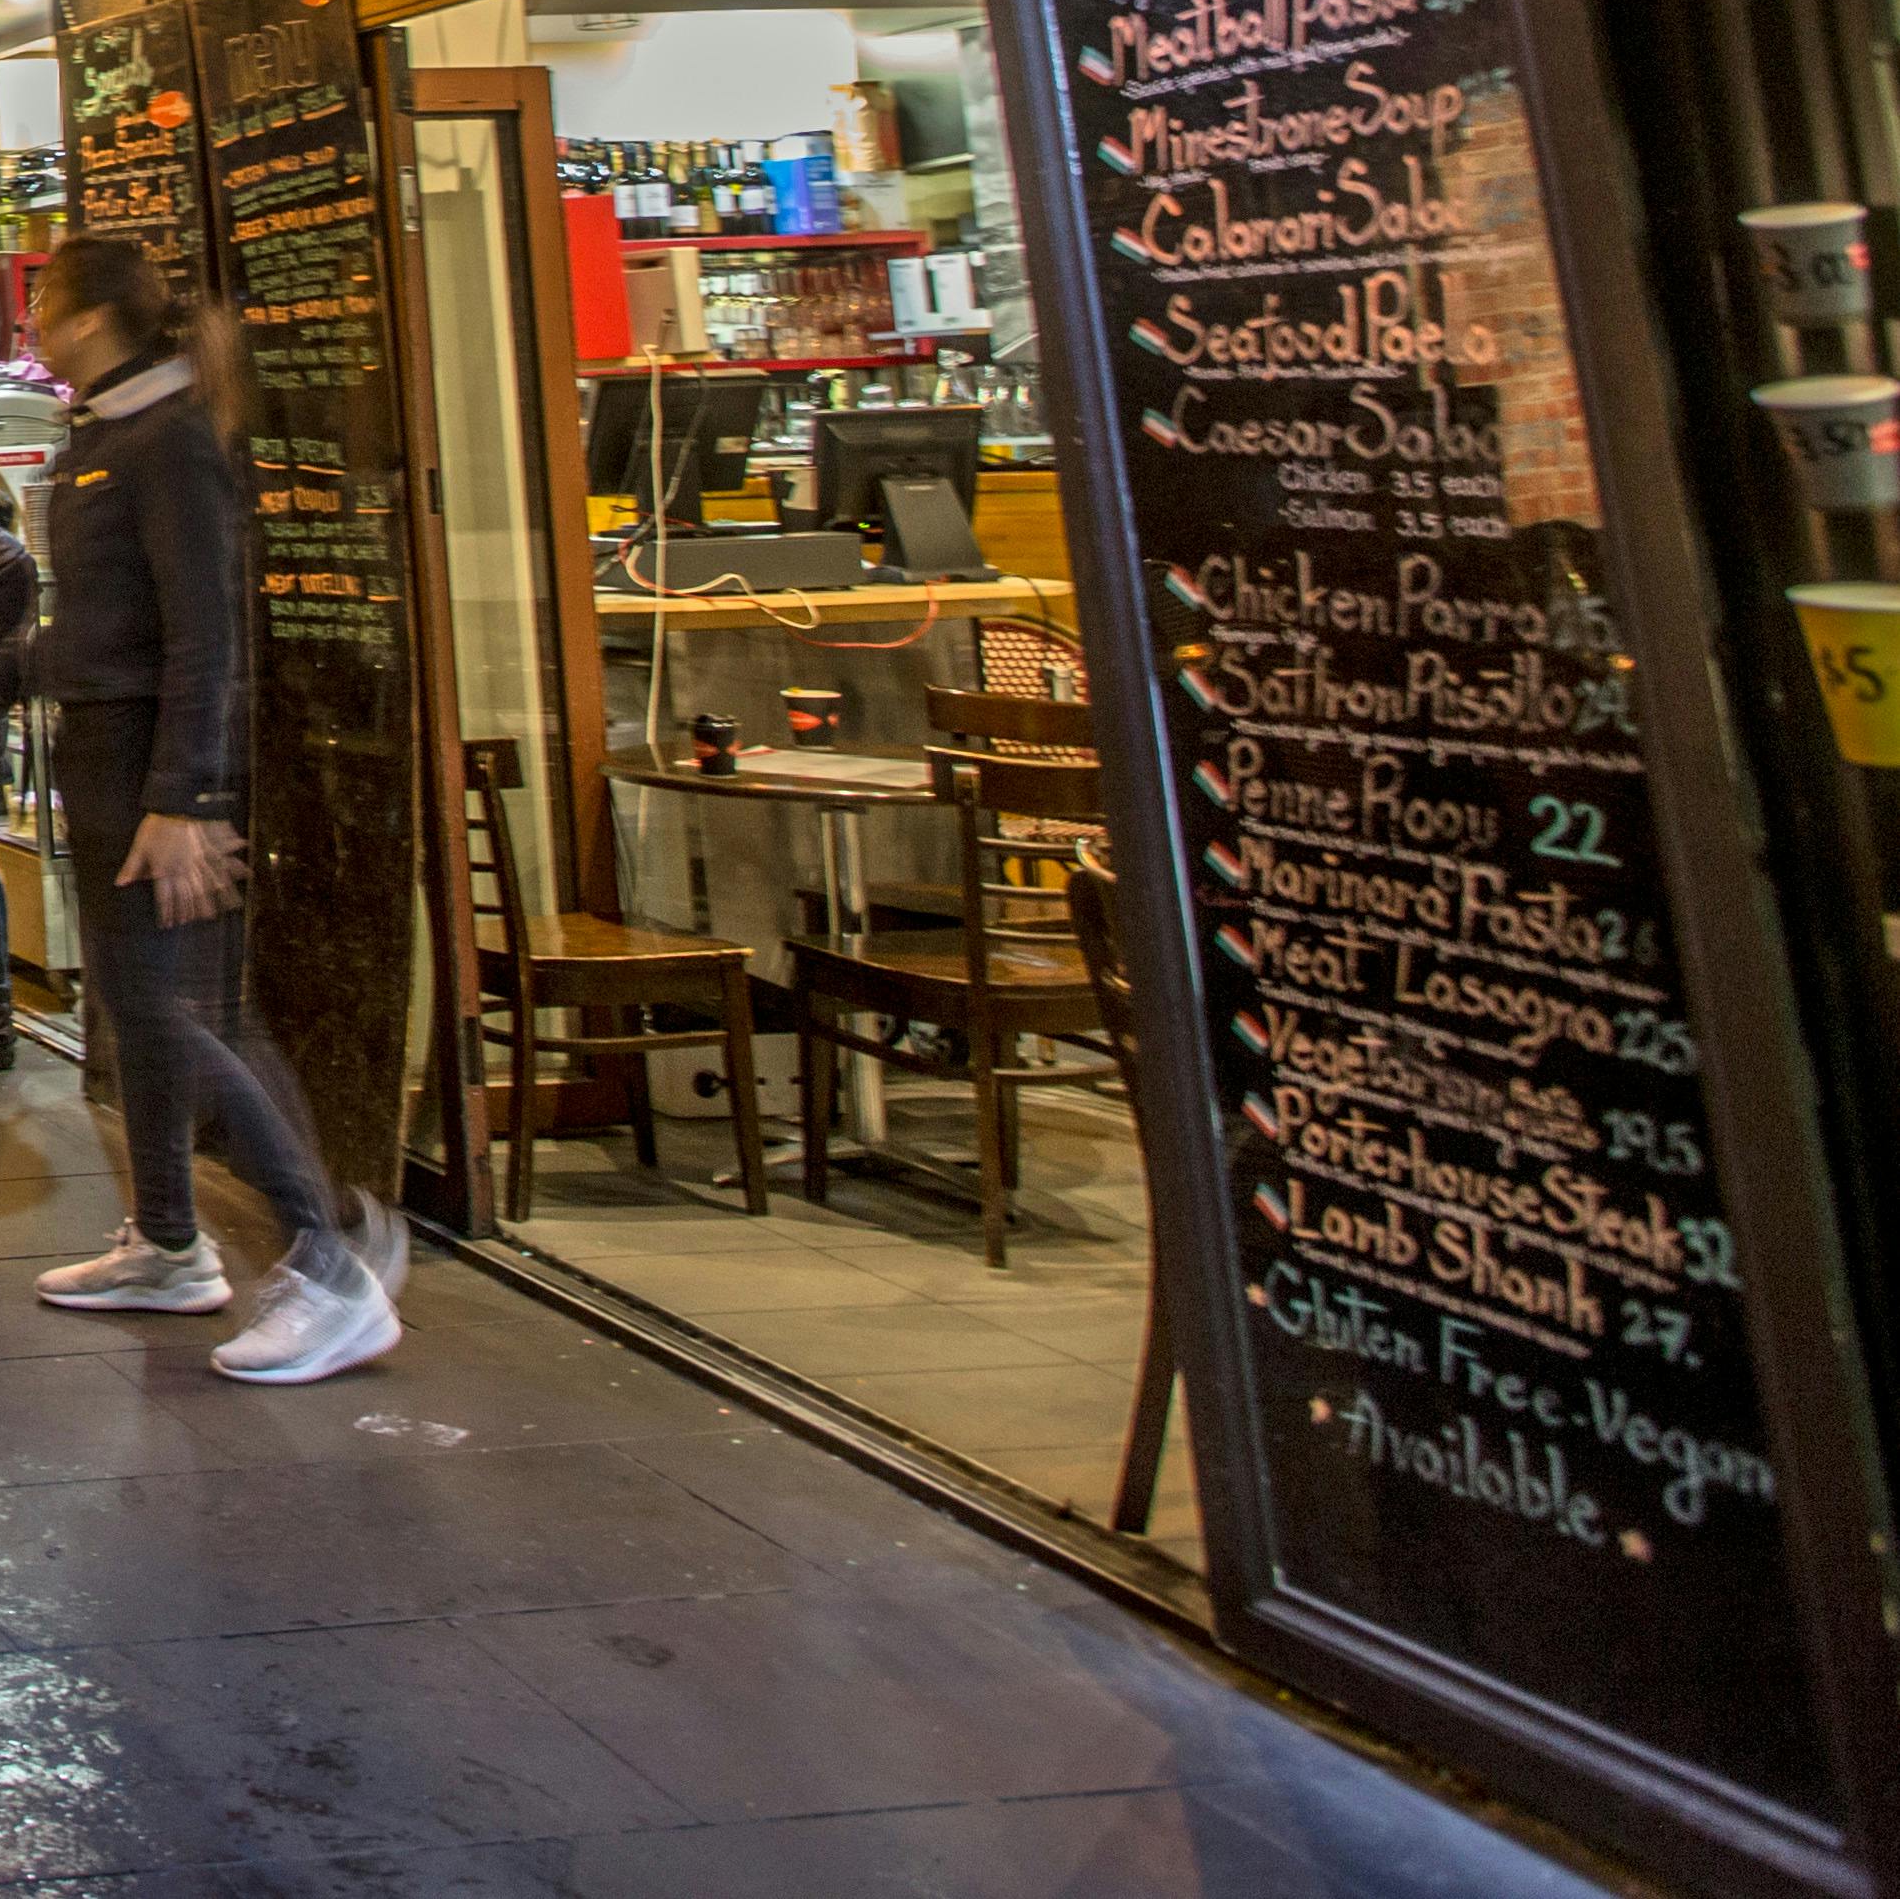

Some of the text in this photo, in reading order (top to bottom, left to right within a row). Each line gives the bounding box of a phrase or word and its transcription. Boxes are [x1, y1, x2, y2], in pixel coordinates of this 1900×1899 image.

[1129, 79, 1351, 173] Minestrone
[1344, 62, 1462, 158] Soup
[1142, 179, 1336, 266] Calamari
[1163, 284, 1362, 369] Seafood
[1174, 384, 1345, 456] Caesar
[1199, 550, 1393, 636] Chicken
[1228, 737, 1354, 831] Penne
[1527, 794, 1624, 868] 22
[1240, 835, 1452, 931] Marinara
[1459, 864, 1601, 960] Pasta
[1249, 918, 1381, 993] Meat
[1273, 1086, 1544, 1222] Porterhouse
[1542, 1165, 1685, 1271] Steak
[1288, 1180, 1421, 1265] Lamb
[1430, 1221, 1604, 1335] Shank
[1264, 1261, 1426, 1374] Gluten
[1339, 1391, 1604, 1546] Available
